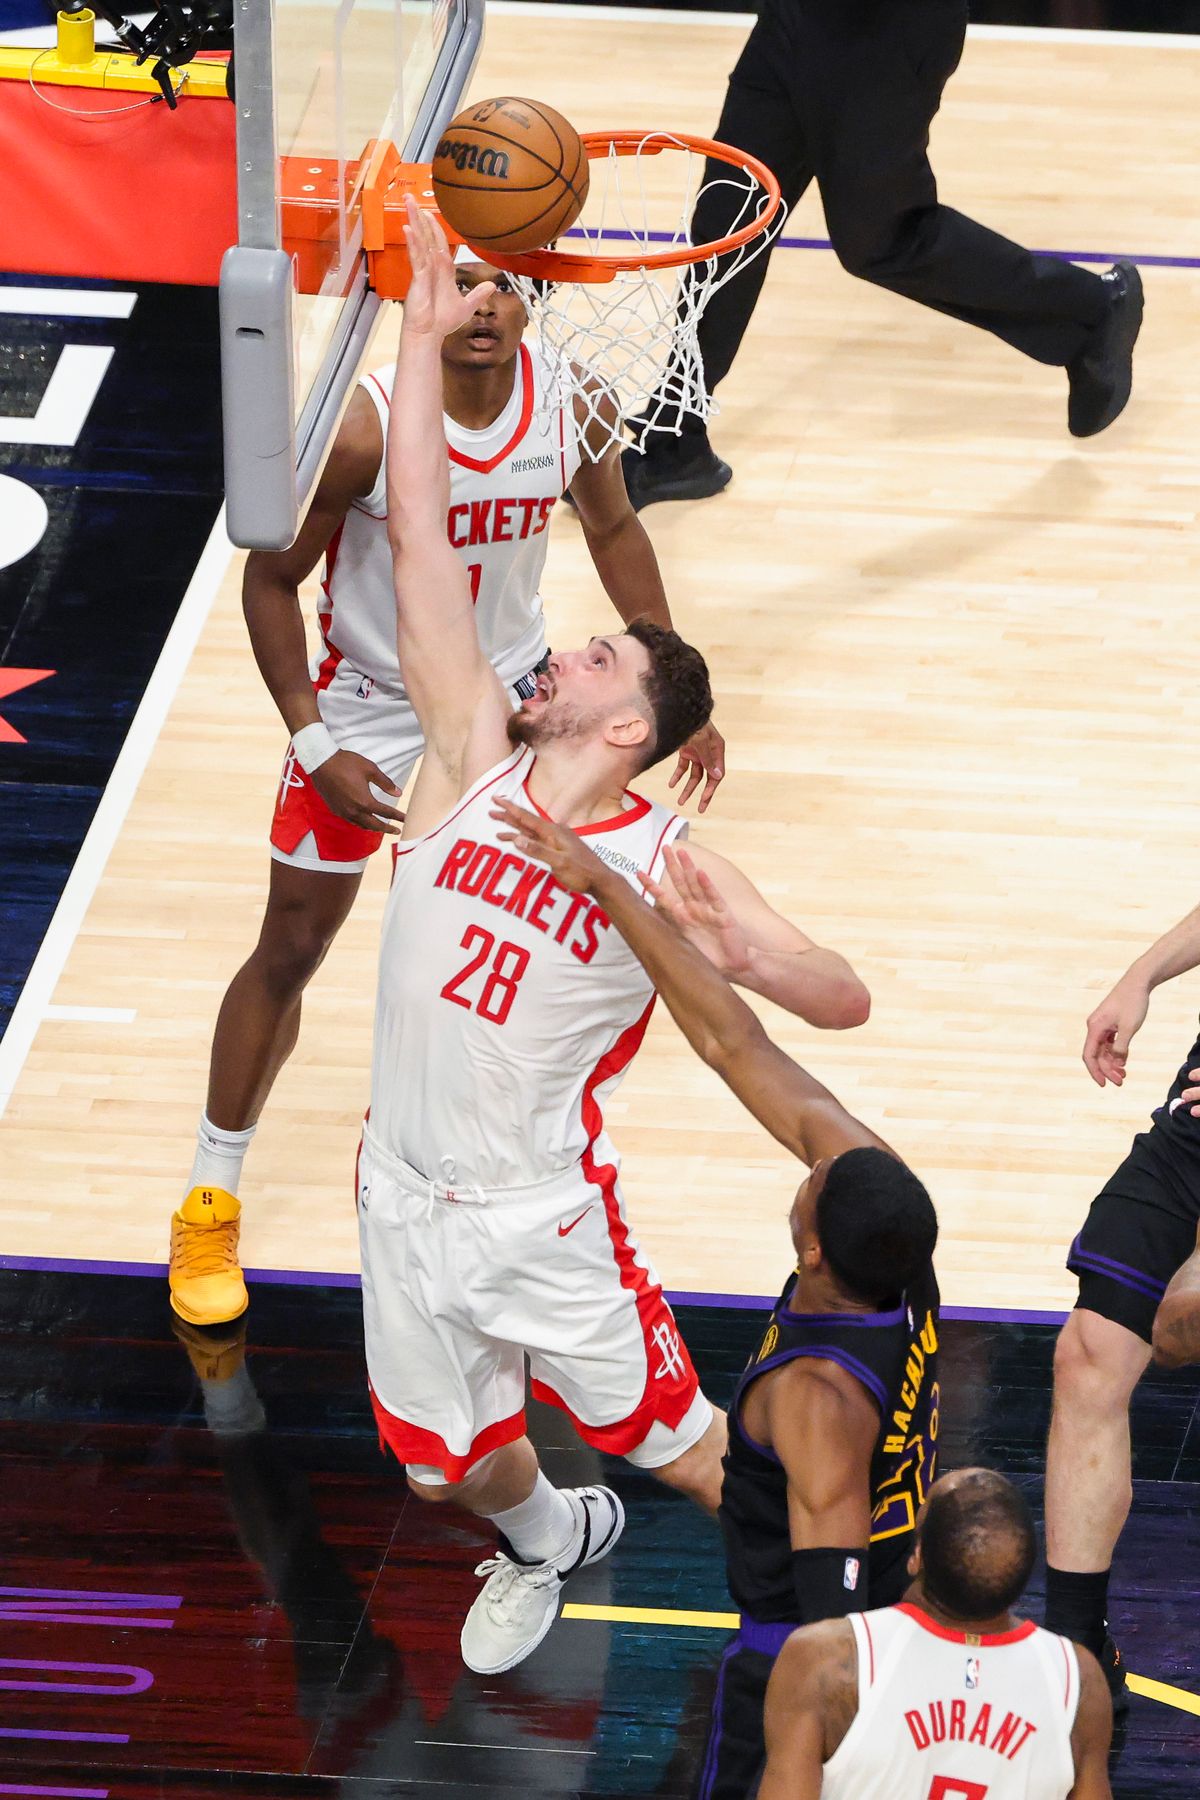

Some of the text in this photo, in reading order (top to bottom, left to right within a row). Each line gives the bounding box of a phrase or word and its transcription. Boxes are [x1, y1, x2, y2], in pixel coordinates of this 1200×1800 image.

[434, 140, 510, 179] Wilso
[447, 496, 558, 549] CKETS
[433, 838, 613, 964] ROCKETS
[440, 923, 531, 1026] 28
[904, 1699, 1038, 1761] DURANT
